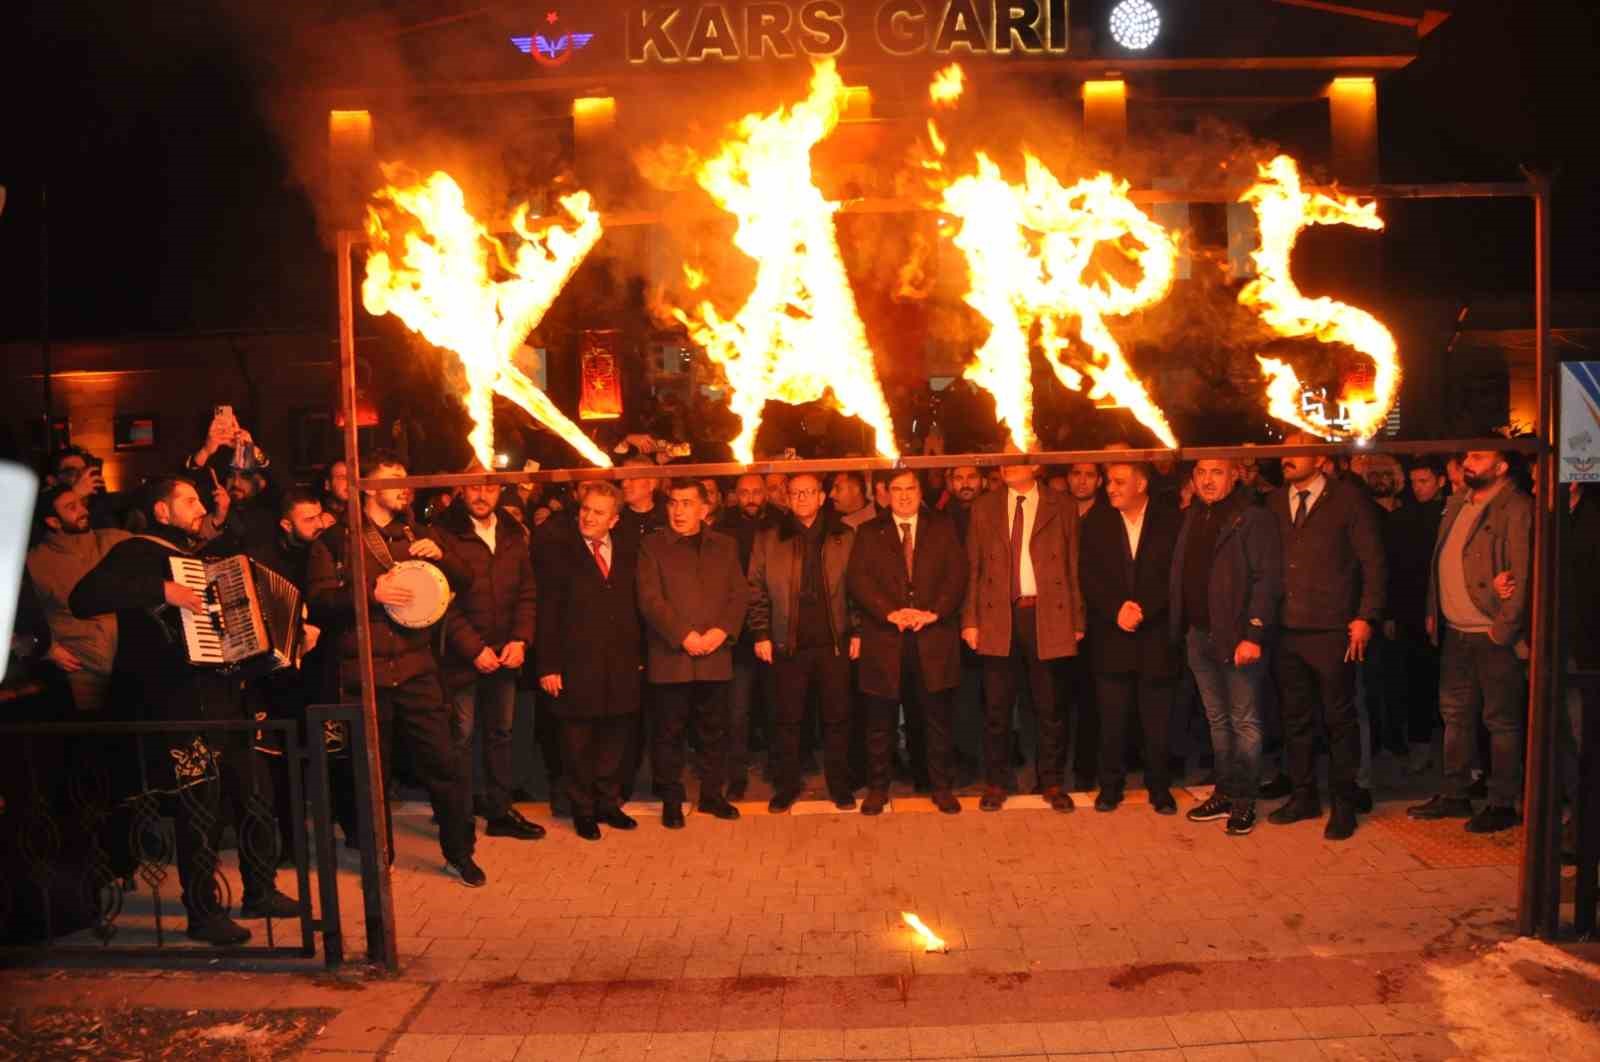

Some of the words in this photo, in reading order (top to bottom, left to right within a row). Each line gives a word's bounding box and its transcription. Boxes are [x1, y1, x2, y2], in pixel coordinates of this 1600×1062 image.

[625, 0, 848, 63] KARS
[874, 0, 1068, 55] GARI
[362, 70, 1403, 469] KARS
